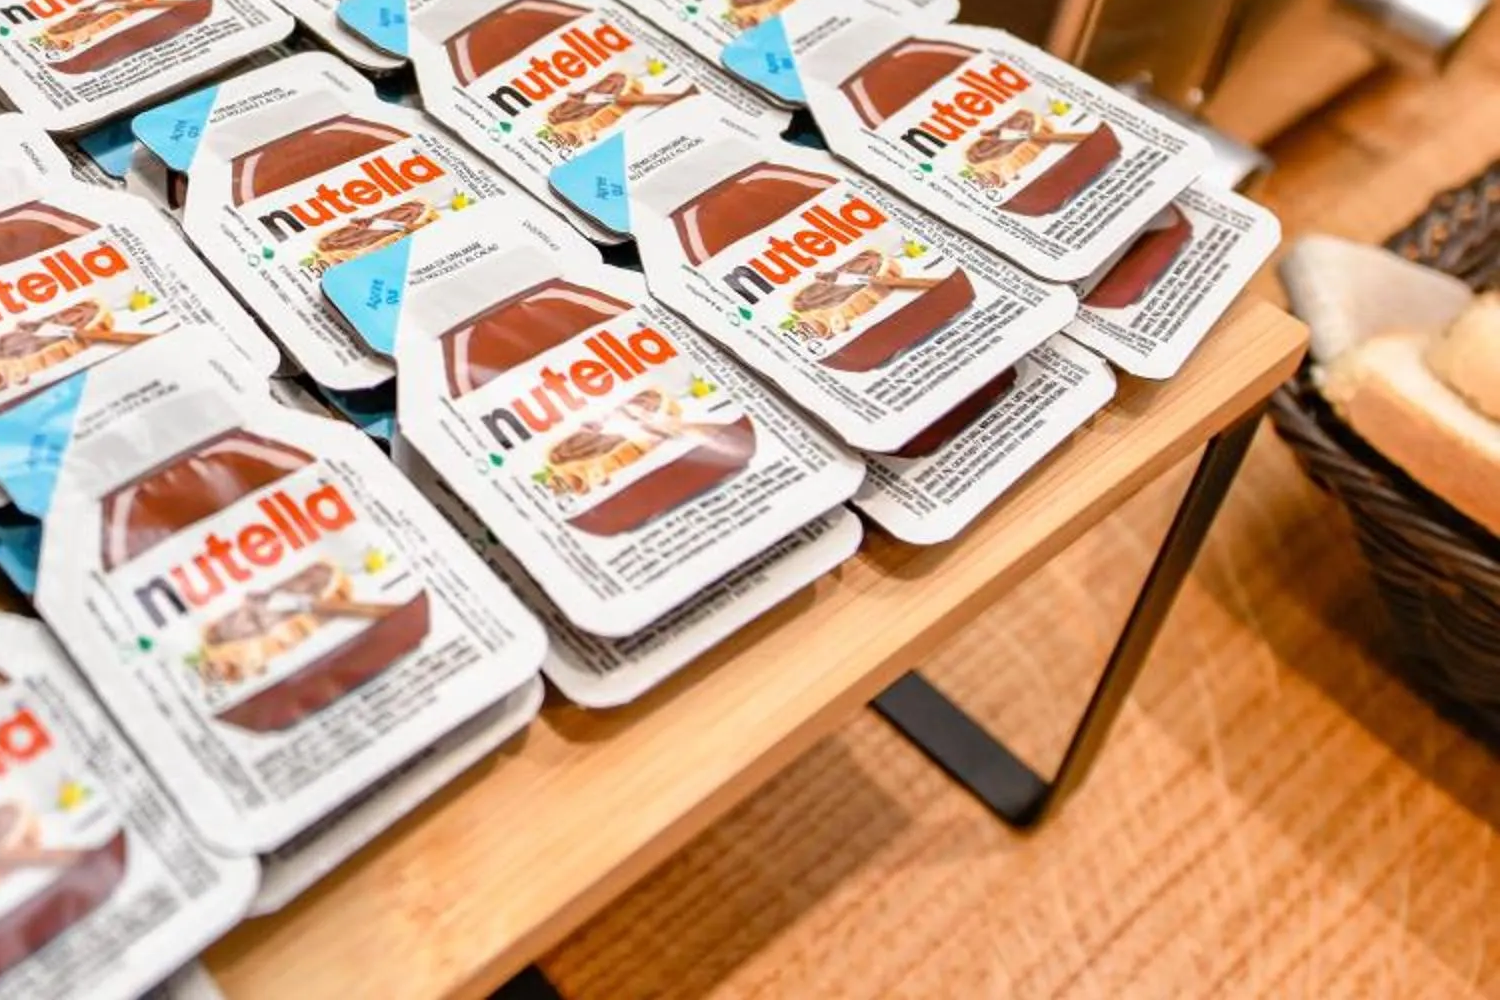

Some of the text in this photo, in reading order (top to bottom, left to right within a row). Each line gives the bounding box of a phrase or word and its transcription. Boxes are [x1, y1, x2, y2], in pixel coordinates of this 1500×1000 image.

[487, 22, 633, 117] nutella
[900, 62, 1032, 158] nutella
[257, 152, 446, 243] nutella
[721, 196, 889, 306] nutella
[480, 327, 679, 451] nutella
[134, 483, 357, 628] nutella
